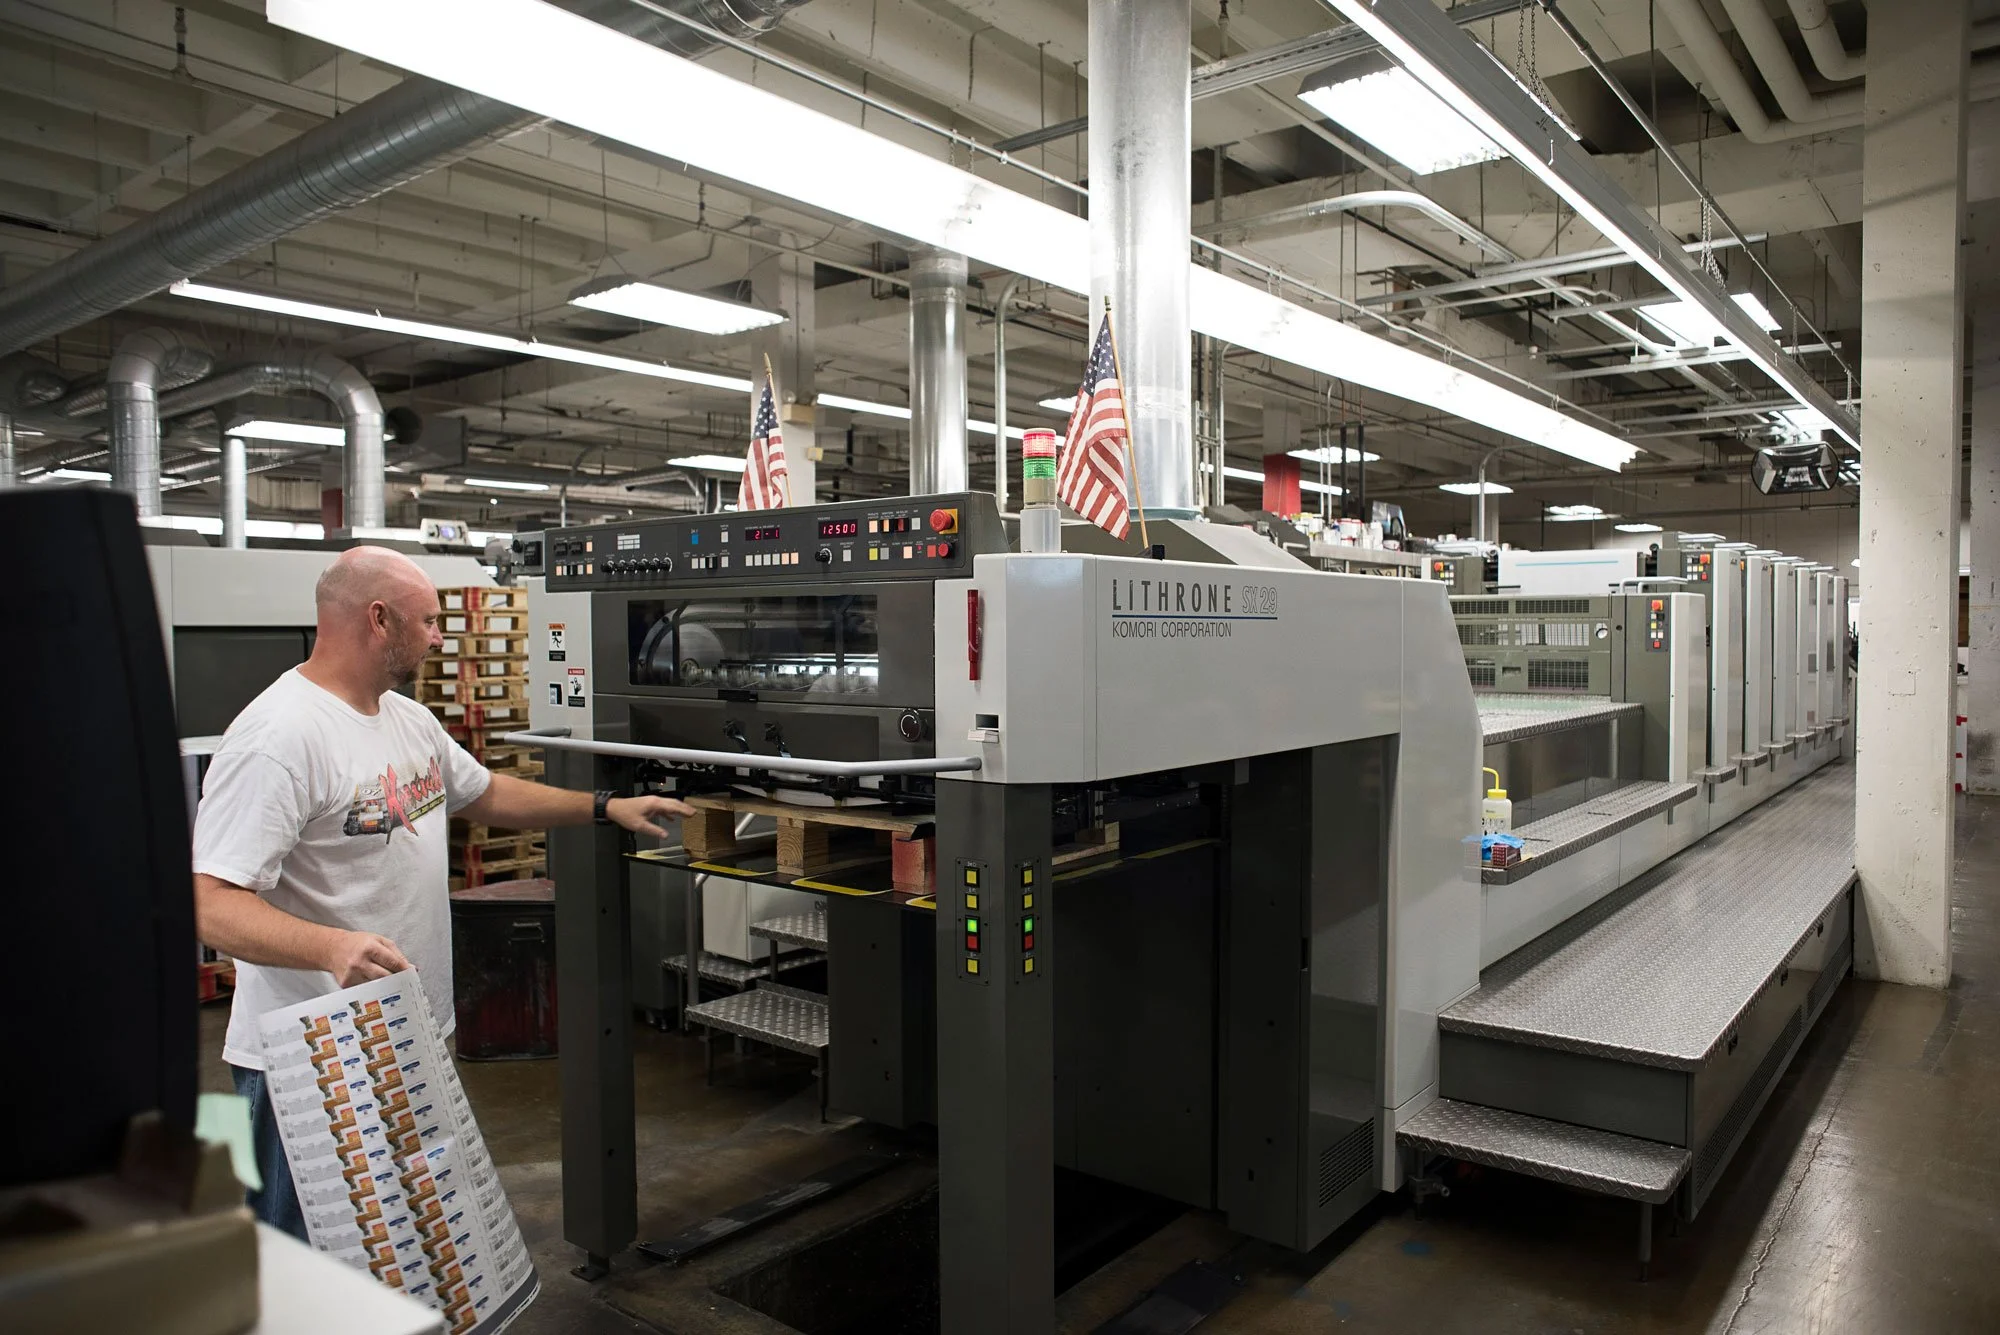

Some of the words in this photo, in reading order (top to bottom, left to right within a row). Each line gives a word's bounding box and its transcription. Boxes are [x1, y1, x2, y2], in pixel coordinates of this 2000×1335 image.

[754, 530, 760, 539] 2
[823, 523, 856, 535] 12500
[1112, 579, 1232, 613] LITHRONE
[1112, 621, 1157, 638] KOMORI
[1161, 621, 1232, 638] CORPORATION
